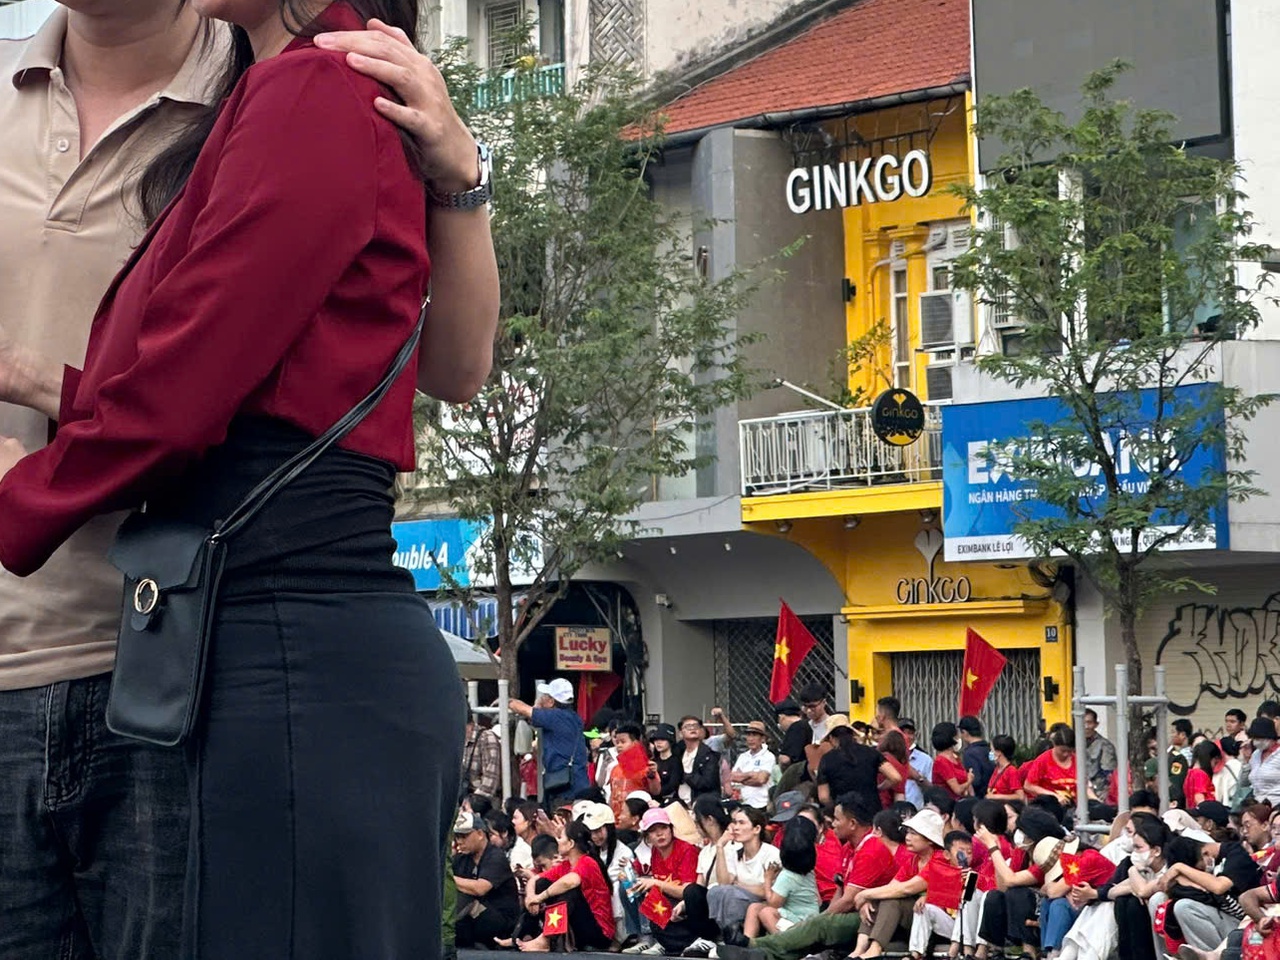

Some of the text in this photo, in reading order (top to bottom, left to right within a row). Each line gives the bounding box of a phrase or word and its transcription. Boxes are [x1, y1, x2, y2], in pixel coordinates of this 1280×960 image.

[786, 149, 930, 214] GINKGO
[969, 489, 993, 504] NGÂN
[996, 488, 1022, 502] HÀNG
[393, 541, 449, 570] ouble A
[958, 544, 991, 554] EXIMBANK
[1046, 627, 1057, 638] 10
[559, 636, 607, 654] Lucky
